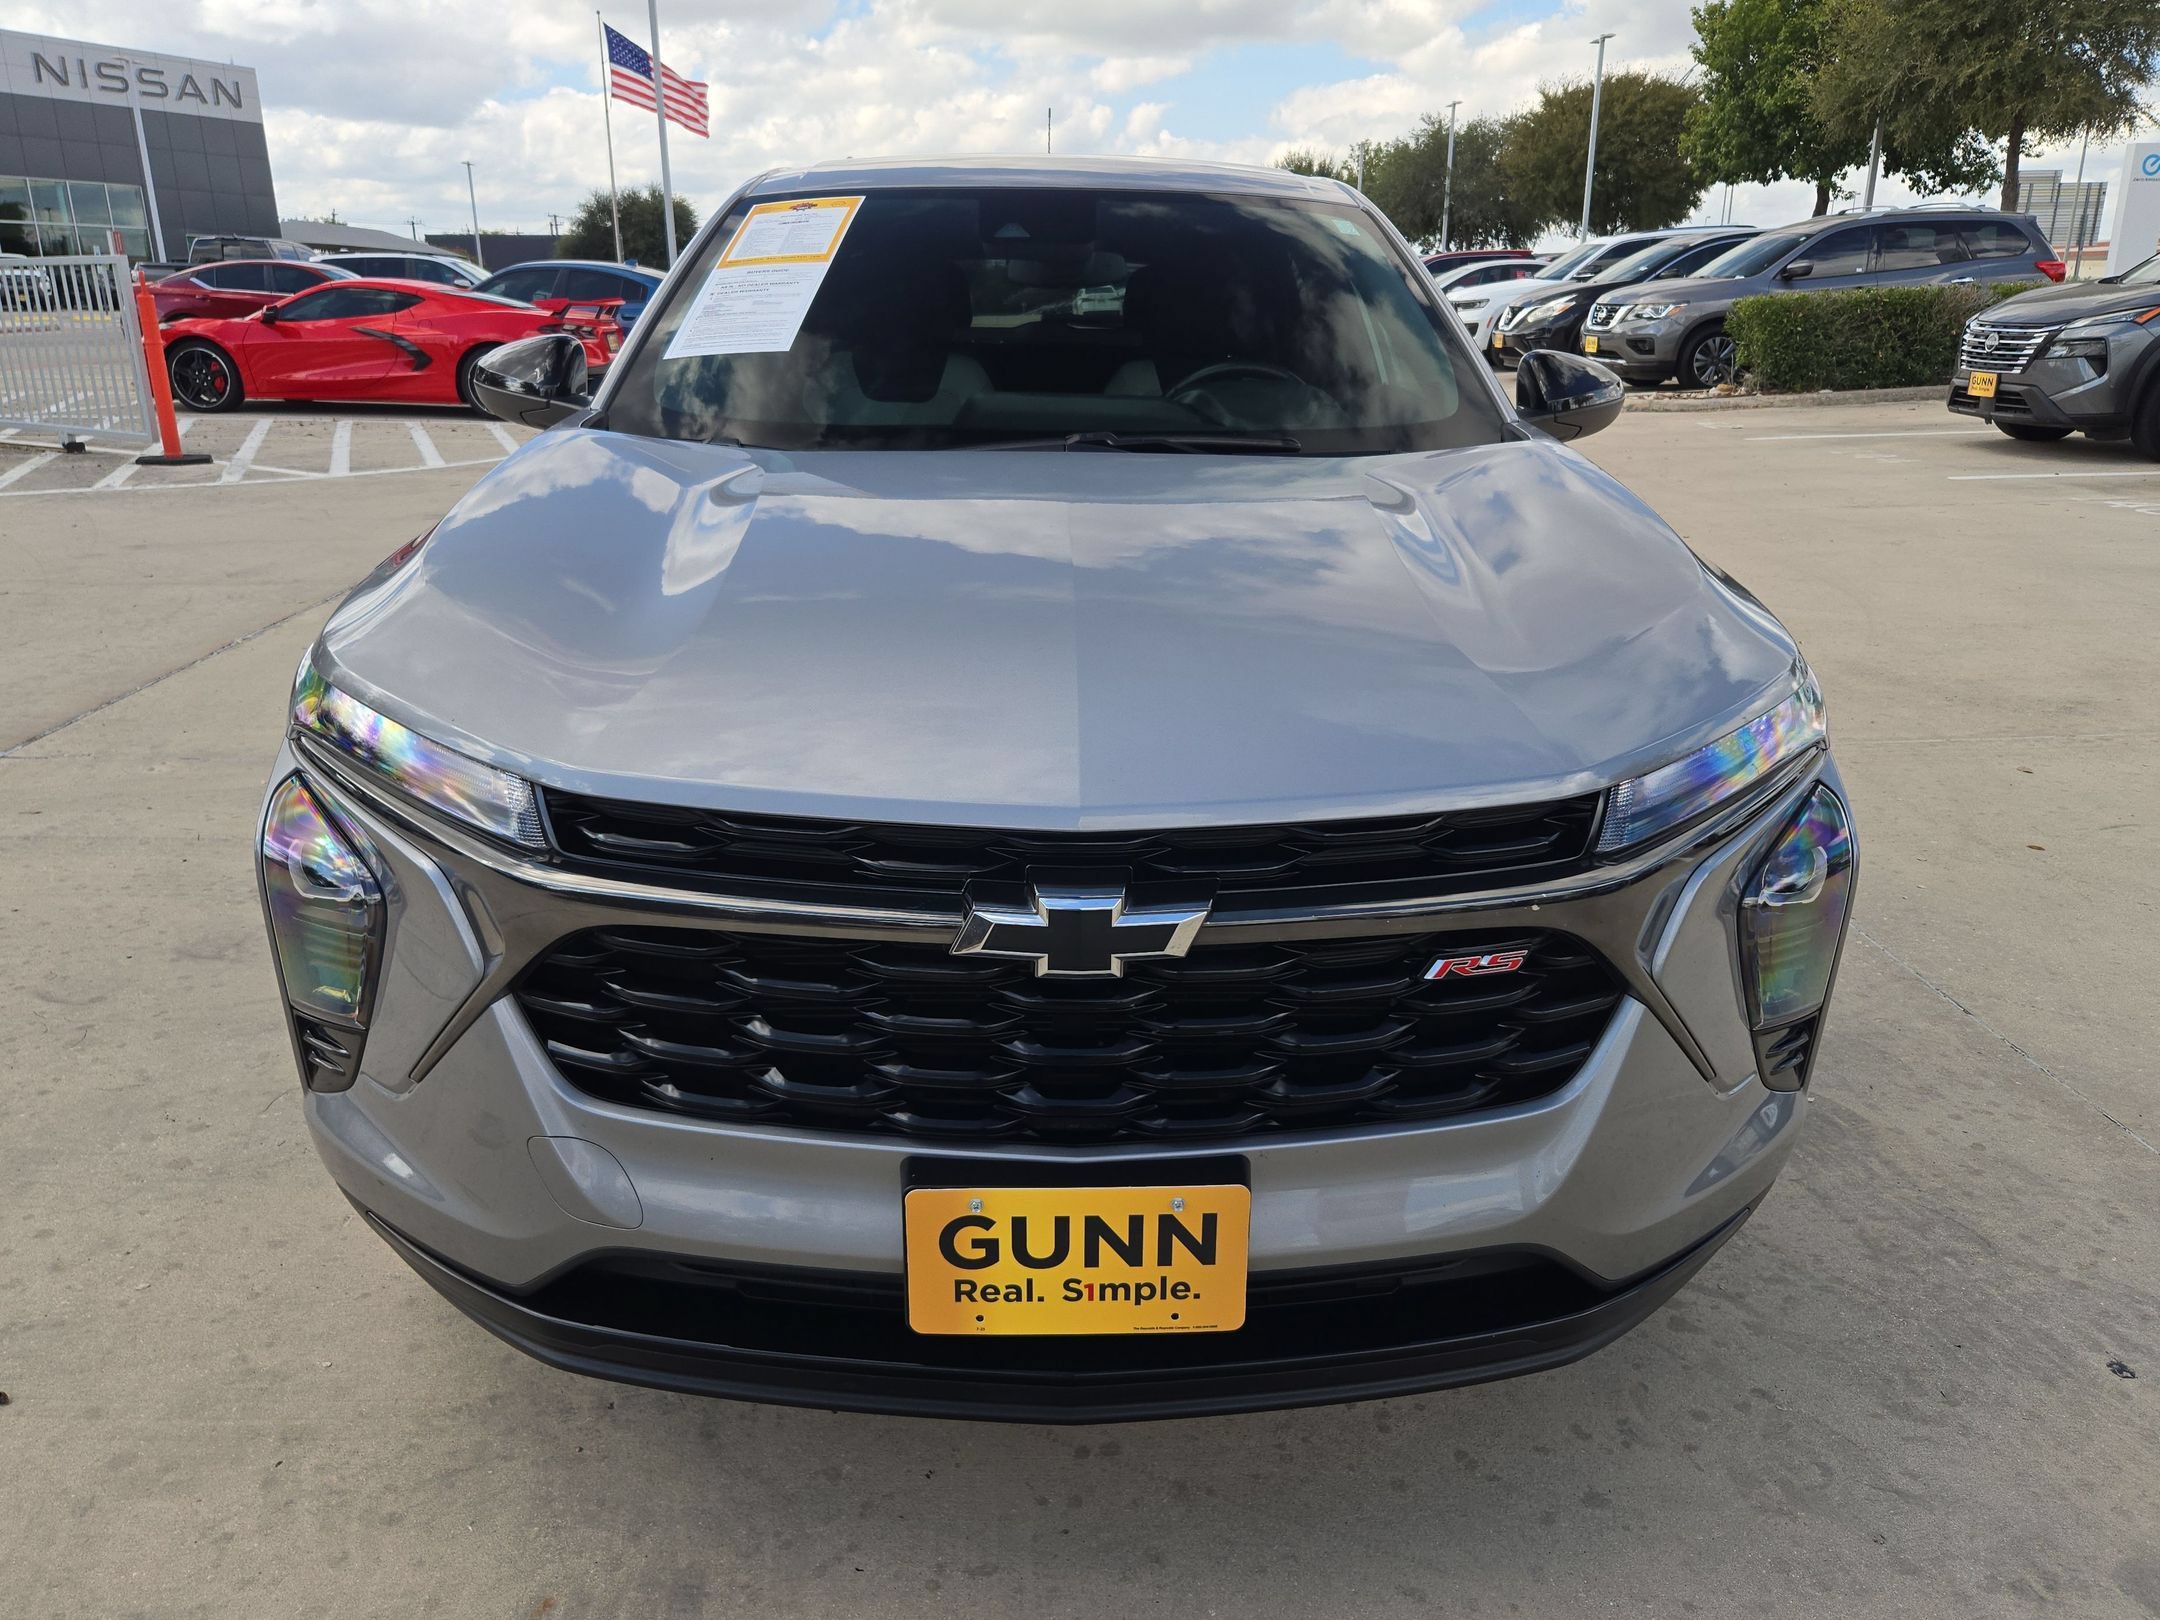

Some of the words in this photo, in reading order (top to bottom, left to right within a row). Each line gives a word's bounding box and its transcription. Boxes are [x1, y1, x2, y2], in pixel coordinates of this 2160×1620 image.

[32, 52, 243, 109] NISSAN
[1972, 376, 1994, 387] GUNN
[1424, 949, 1528, 980] RS
[939, 1213, 1218, 1270] GUNN
[954, 1278, 1045, 1303] Real.
